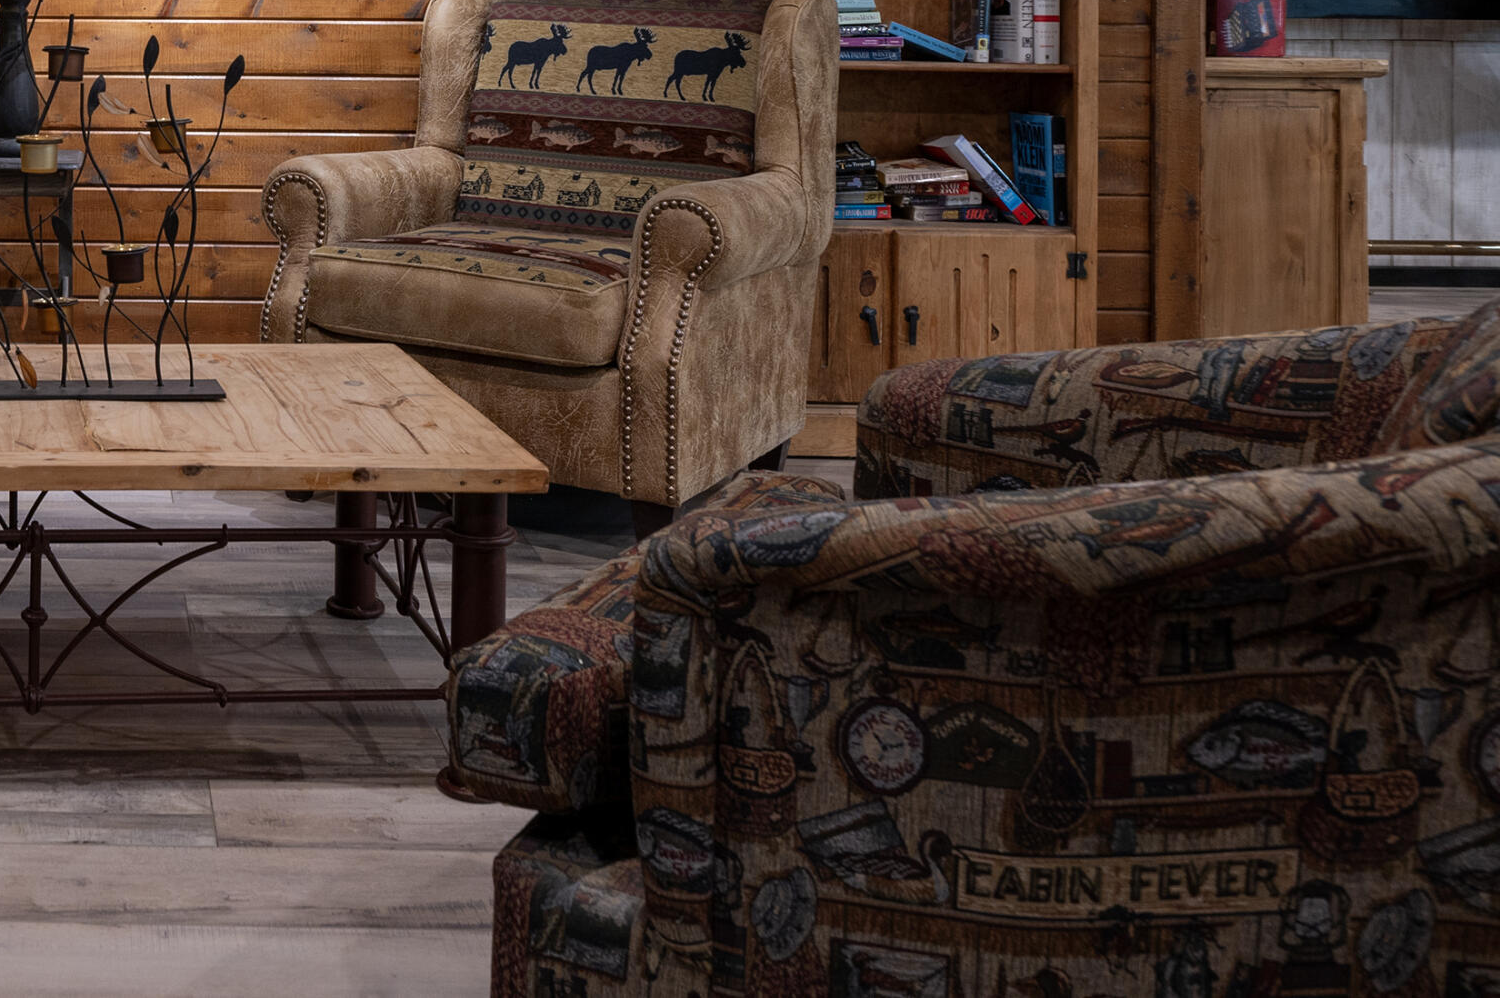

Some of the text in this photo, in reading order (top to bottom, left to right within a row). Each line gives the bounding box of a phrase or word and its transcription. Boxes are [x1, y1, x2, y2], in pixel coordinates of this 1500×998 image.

[857, 710, 921, 750] TIME FOR
[859, 754, 916, 783] FISHING
[963, 858, 1282, 904] CABIN FEVER
